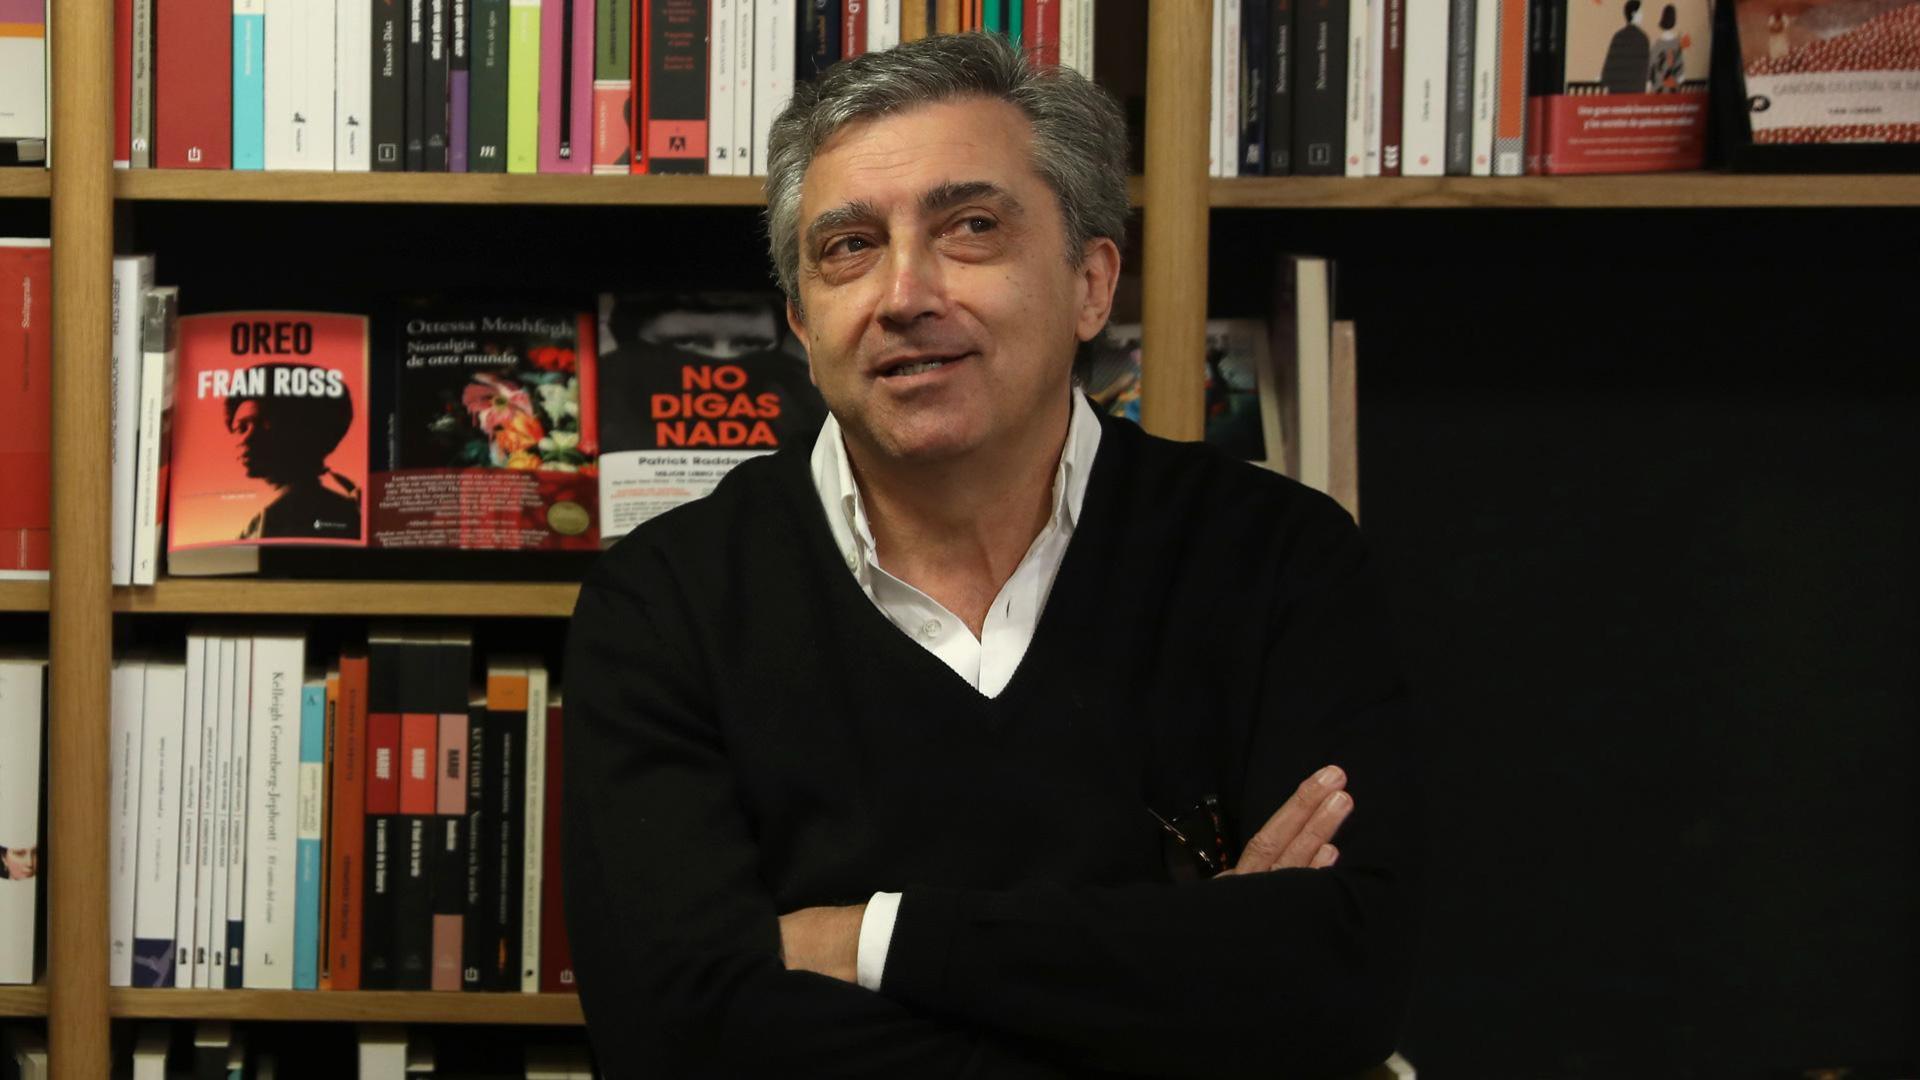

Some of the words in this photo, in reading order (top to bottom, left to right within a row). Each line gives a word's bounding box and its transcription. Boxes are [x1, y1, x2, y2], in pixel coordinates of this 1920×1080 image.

[230, 321, 312, 355] OREO
[407, 320, 476, 335] Ottessa
[482, 317, 574, 338] Moshfegh
[407, 339, 476, 353] Nostalgia
[407, 355, 424, 368] de
[428, 353, 460, 365] otro
[463, 352, 517, 365] mundo
[197, 369, 265, 400] FRAN
[274, 367, 343, 398] ROSS
[682, 365, 748, 390] NO
[651, 393, 781, 420] DIGAS
[656, 421, 779, 448] NADA
[638, 457, 687, 465] Patrick
[267, 671, 284, 722] Kelleigh
[471, 727, 481, 759] KENT
[376, 748, 390, 780] HARUF
[411, 748, 425, 780] HARUF
[447, 749, 460, 779] HARUF
[262, 725, 283, 841] Greenberg-Jephcott
[468, 875, 478, 904] noche
